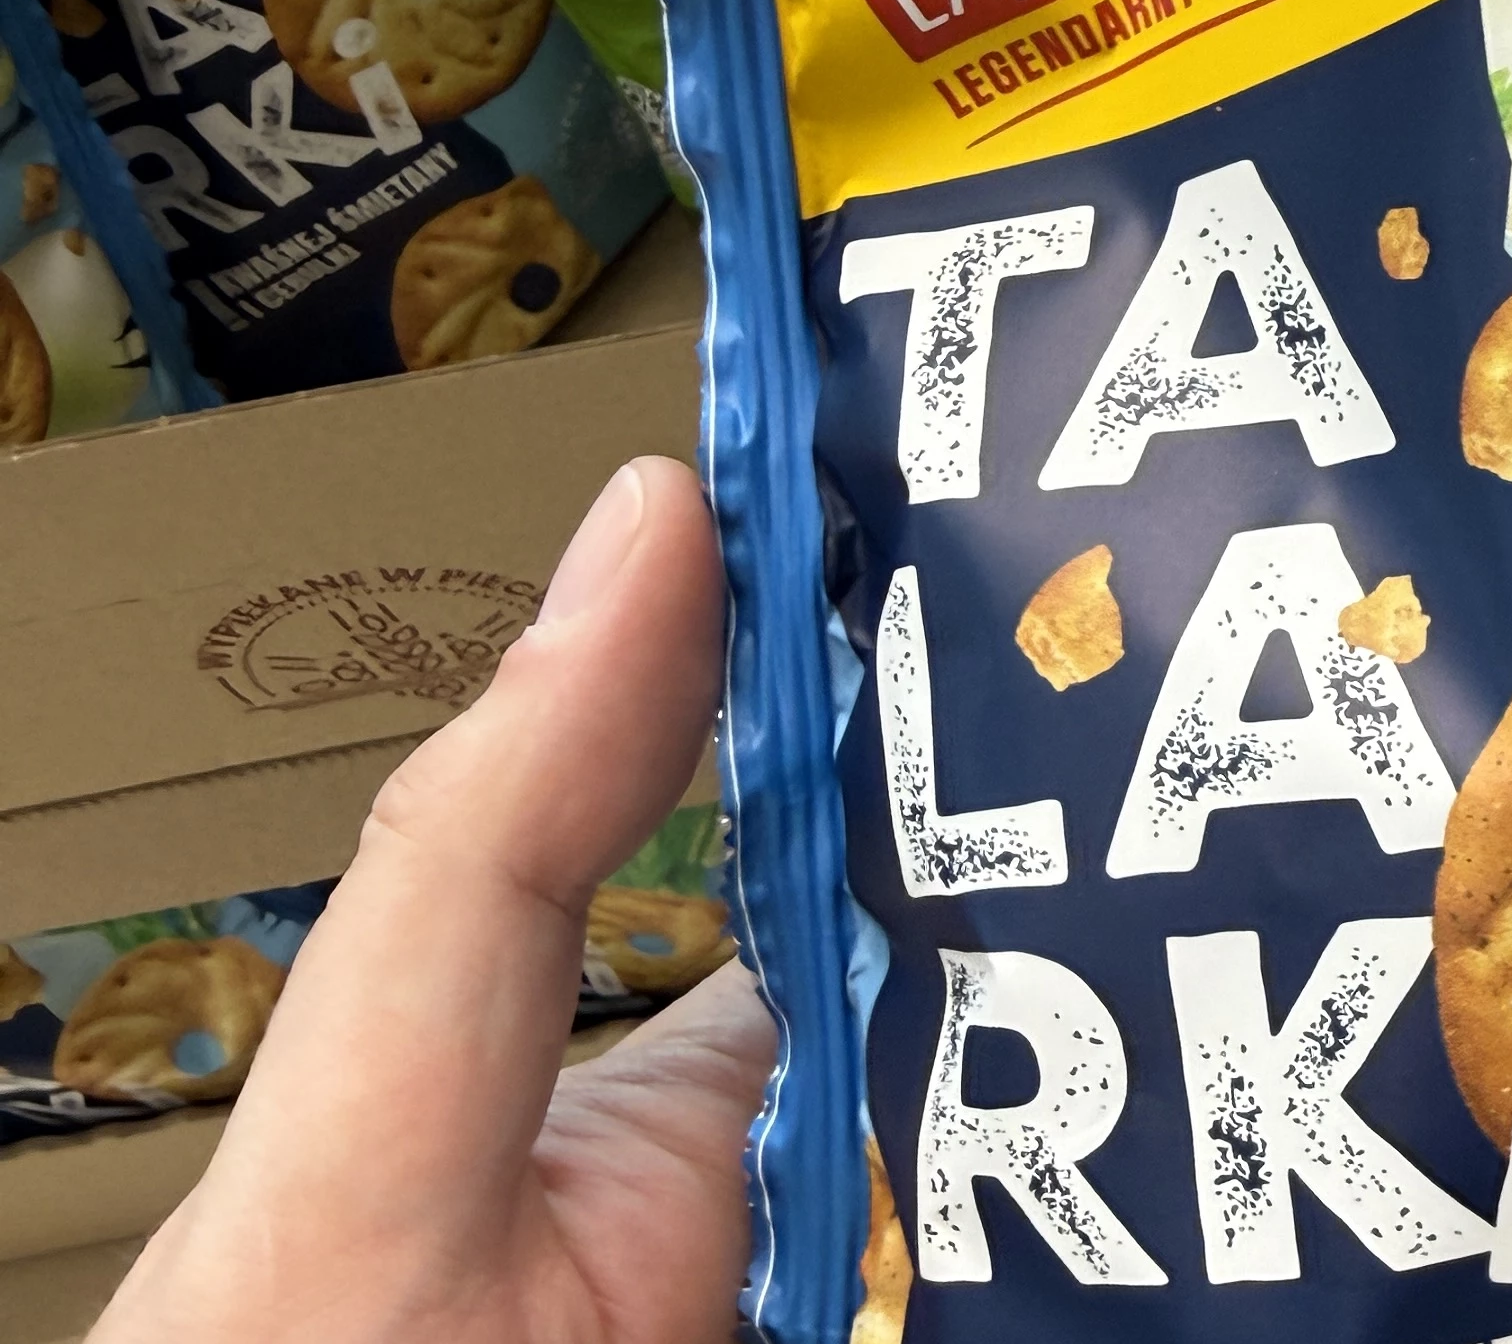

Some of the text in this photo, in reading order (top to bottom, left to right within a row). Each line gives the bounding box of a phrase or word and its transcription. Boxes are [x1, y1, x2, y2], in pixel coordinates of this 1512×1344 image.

[840, 159, 1397, 505] TA
[378, 567, 426, 583] W
[876, 523, 1459, 898] LA
